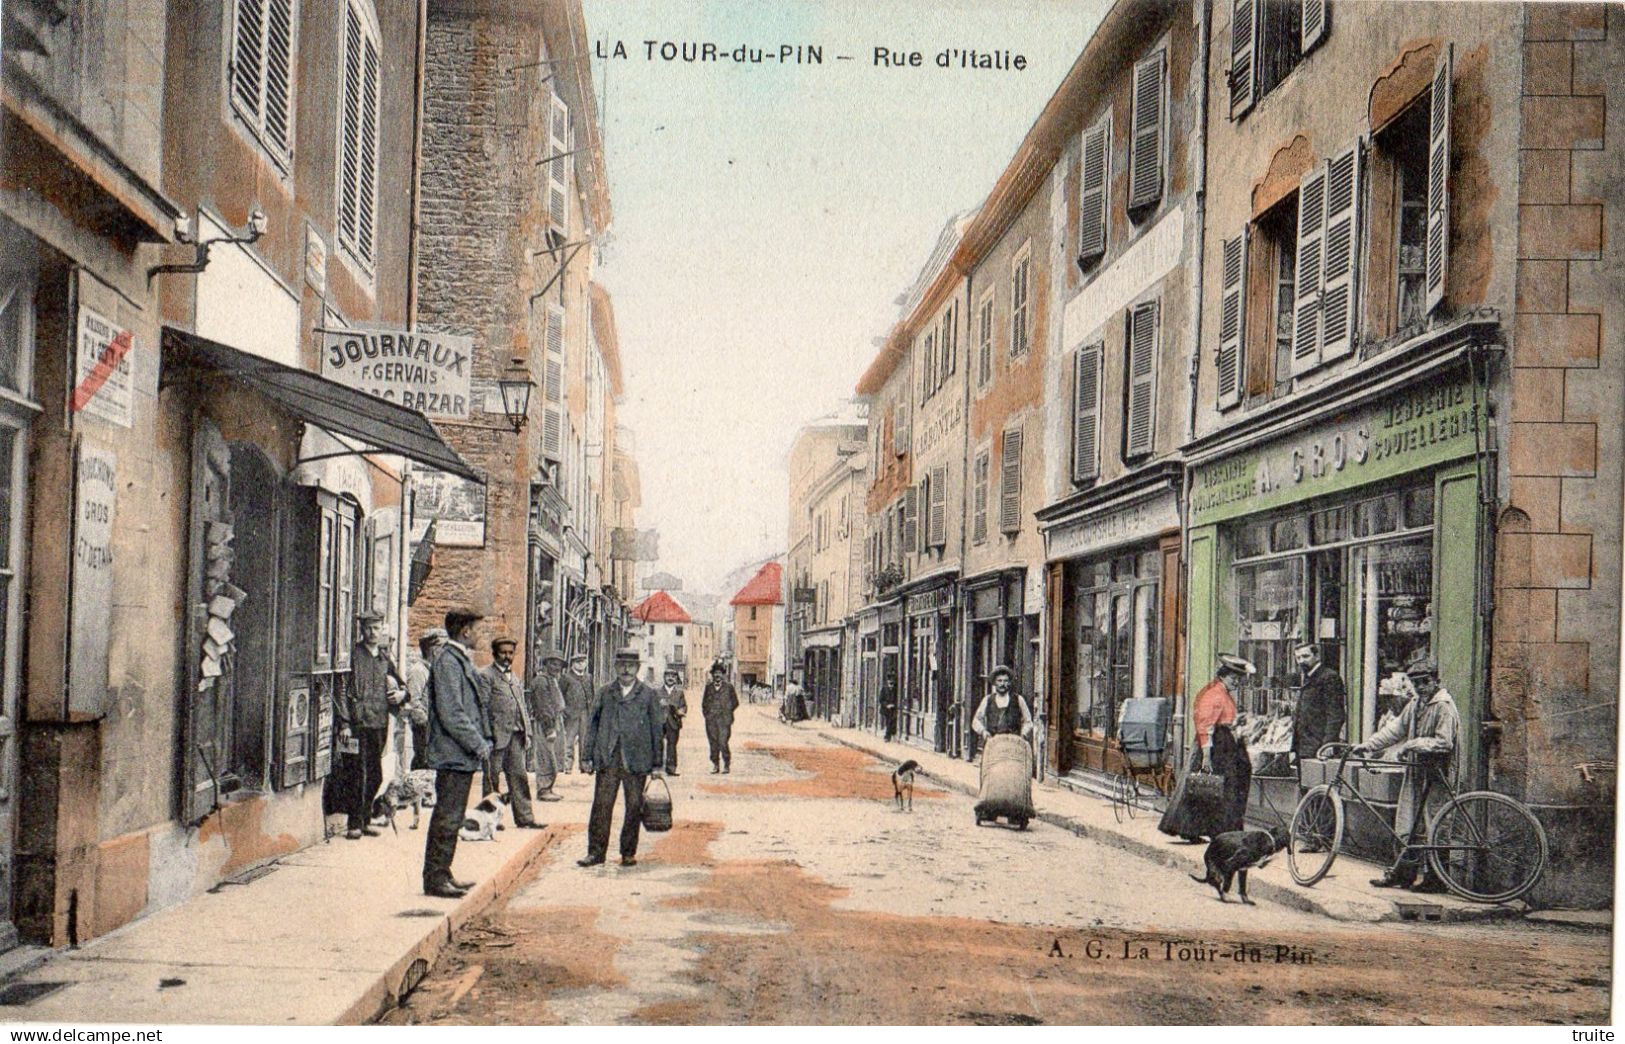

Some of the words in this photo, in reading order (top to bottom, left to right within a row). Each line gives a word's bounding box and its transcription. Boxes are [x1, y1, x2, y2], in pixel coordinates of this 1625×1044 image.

[329, 334, 468, 377] JOURNAUX
[403, 390, 466, 415] BAZAR
[1384, 385, 1462, 428] MERCERIE
[1375, 404, 1479, 460] COUTELLERIE
[1258, 457, 1281, 493] A.
[1291, 426, 1371, 482] GROS
[85, 500, 108, 524] GROS
